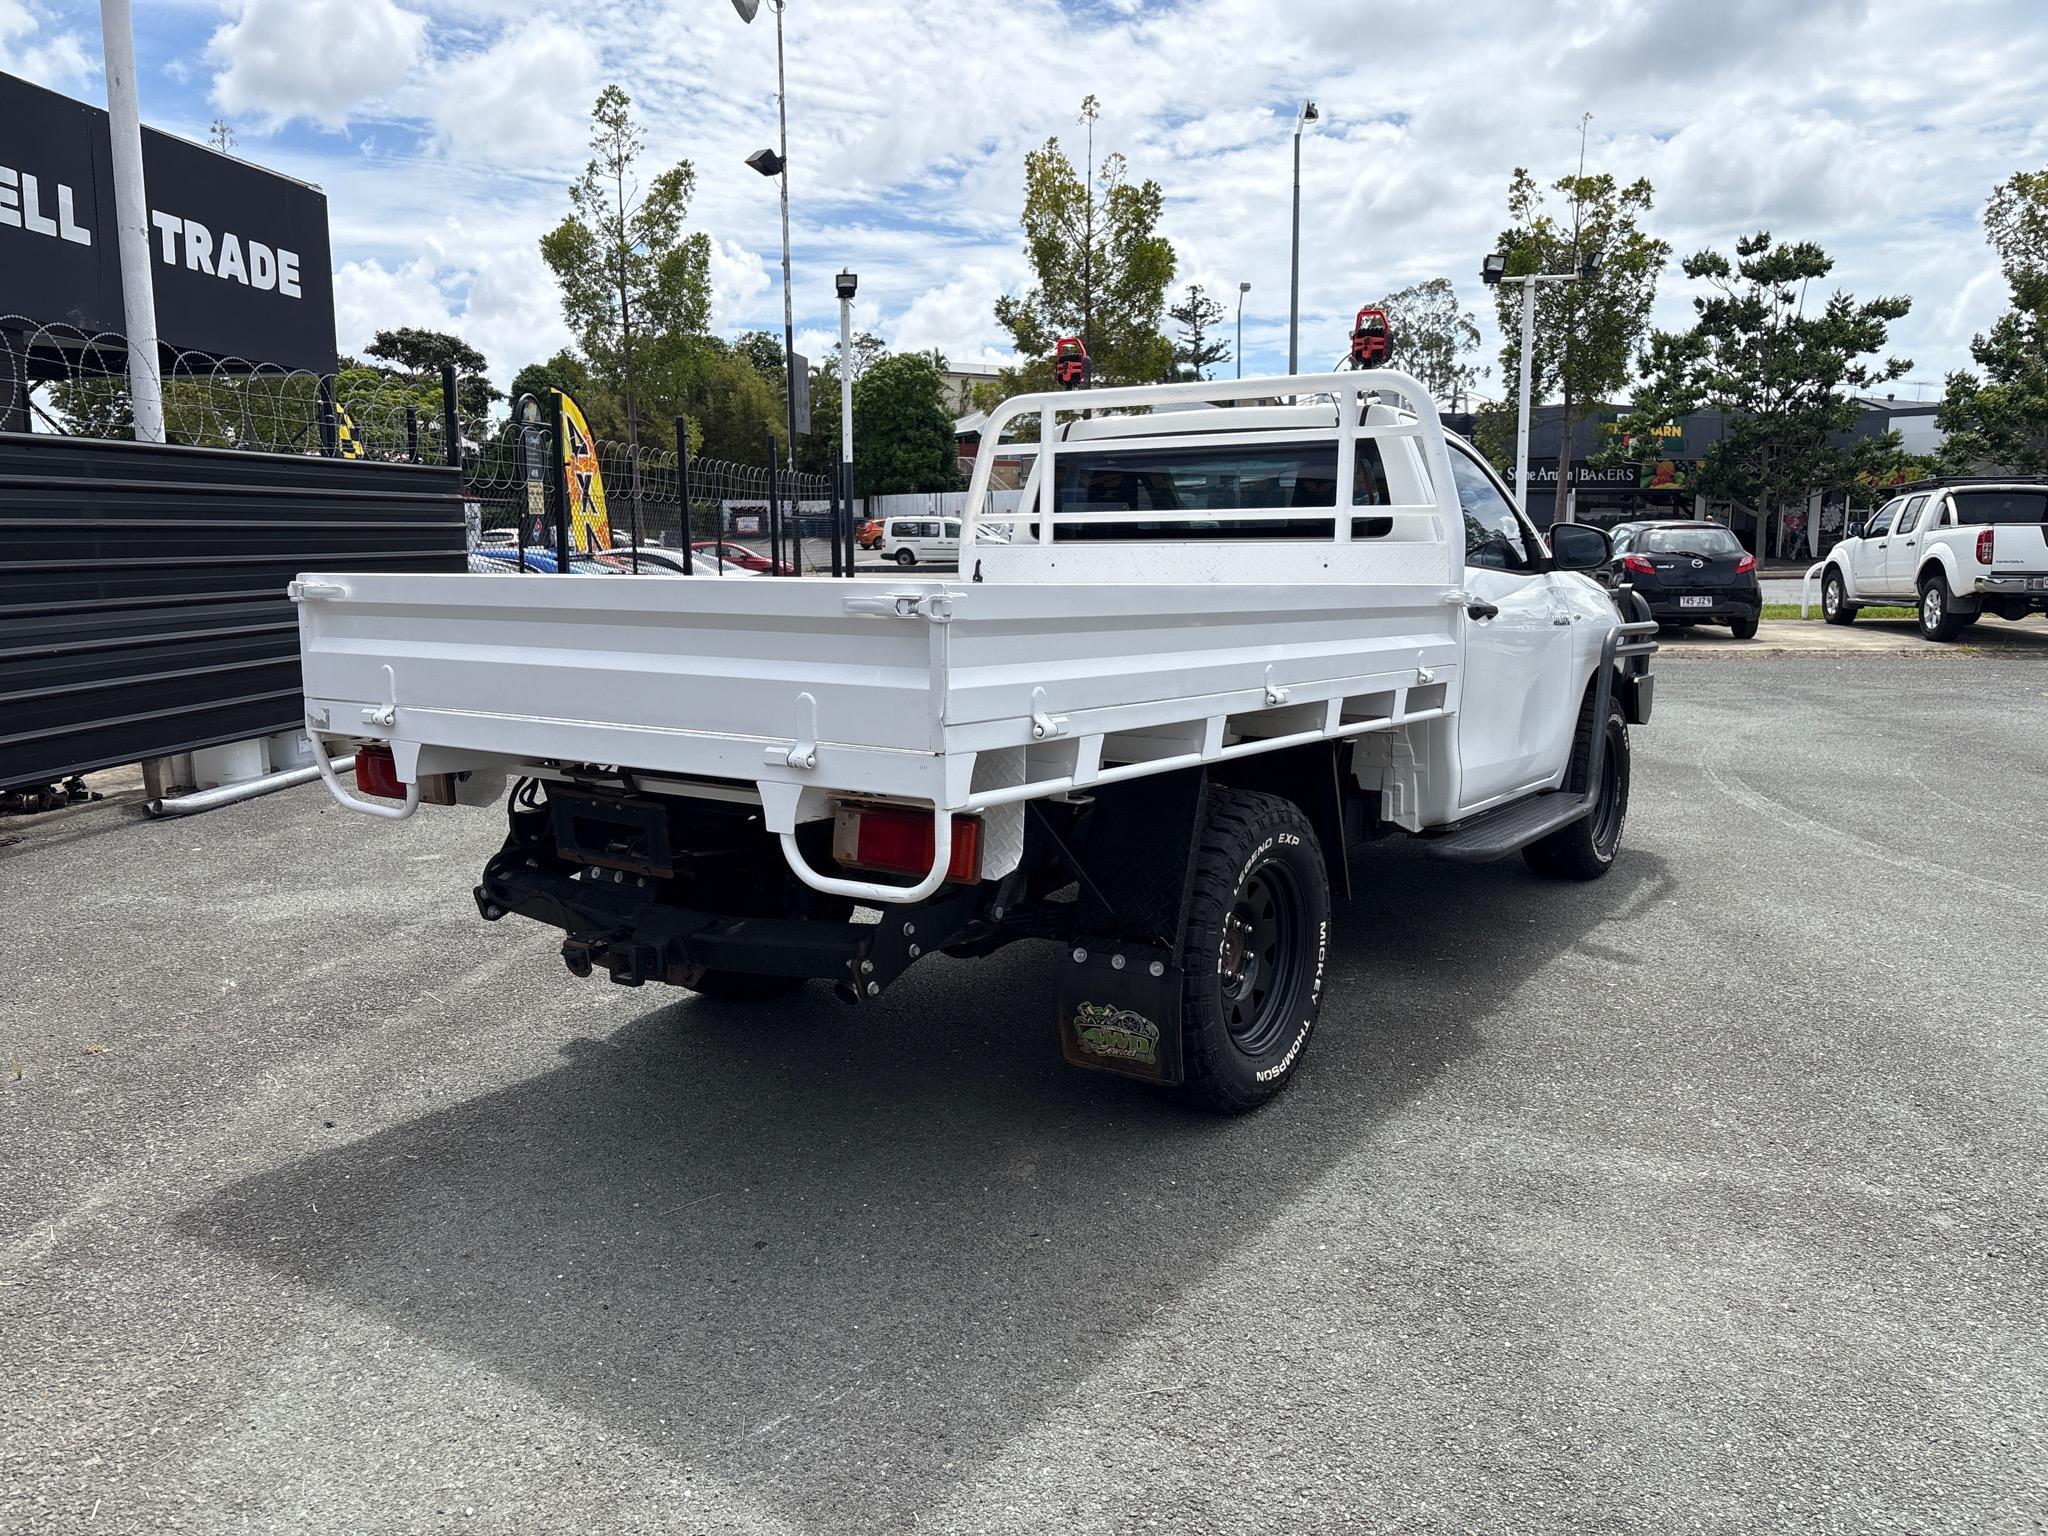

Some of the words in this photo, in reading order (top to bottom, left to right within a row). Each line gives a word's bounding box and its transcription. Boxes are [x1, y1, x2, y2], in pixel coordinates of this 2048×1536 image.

[152, 209, 301, 299] TRADE
[1507, 466, 1536, 481] Sne
[1537, 466, 1573, 481] Artin
[1579, 468, 1634, 481] BAKERS
[1234, 837, 1273, 896] LEGEND
[1278, 833, 1300, 846] EXP
[1311, 921, 1327, 1005] MICKEY
[1256, 1019, 1311, 1082] THOMPSON
